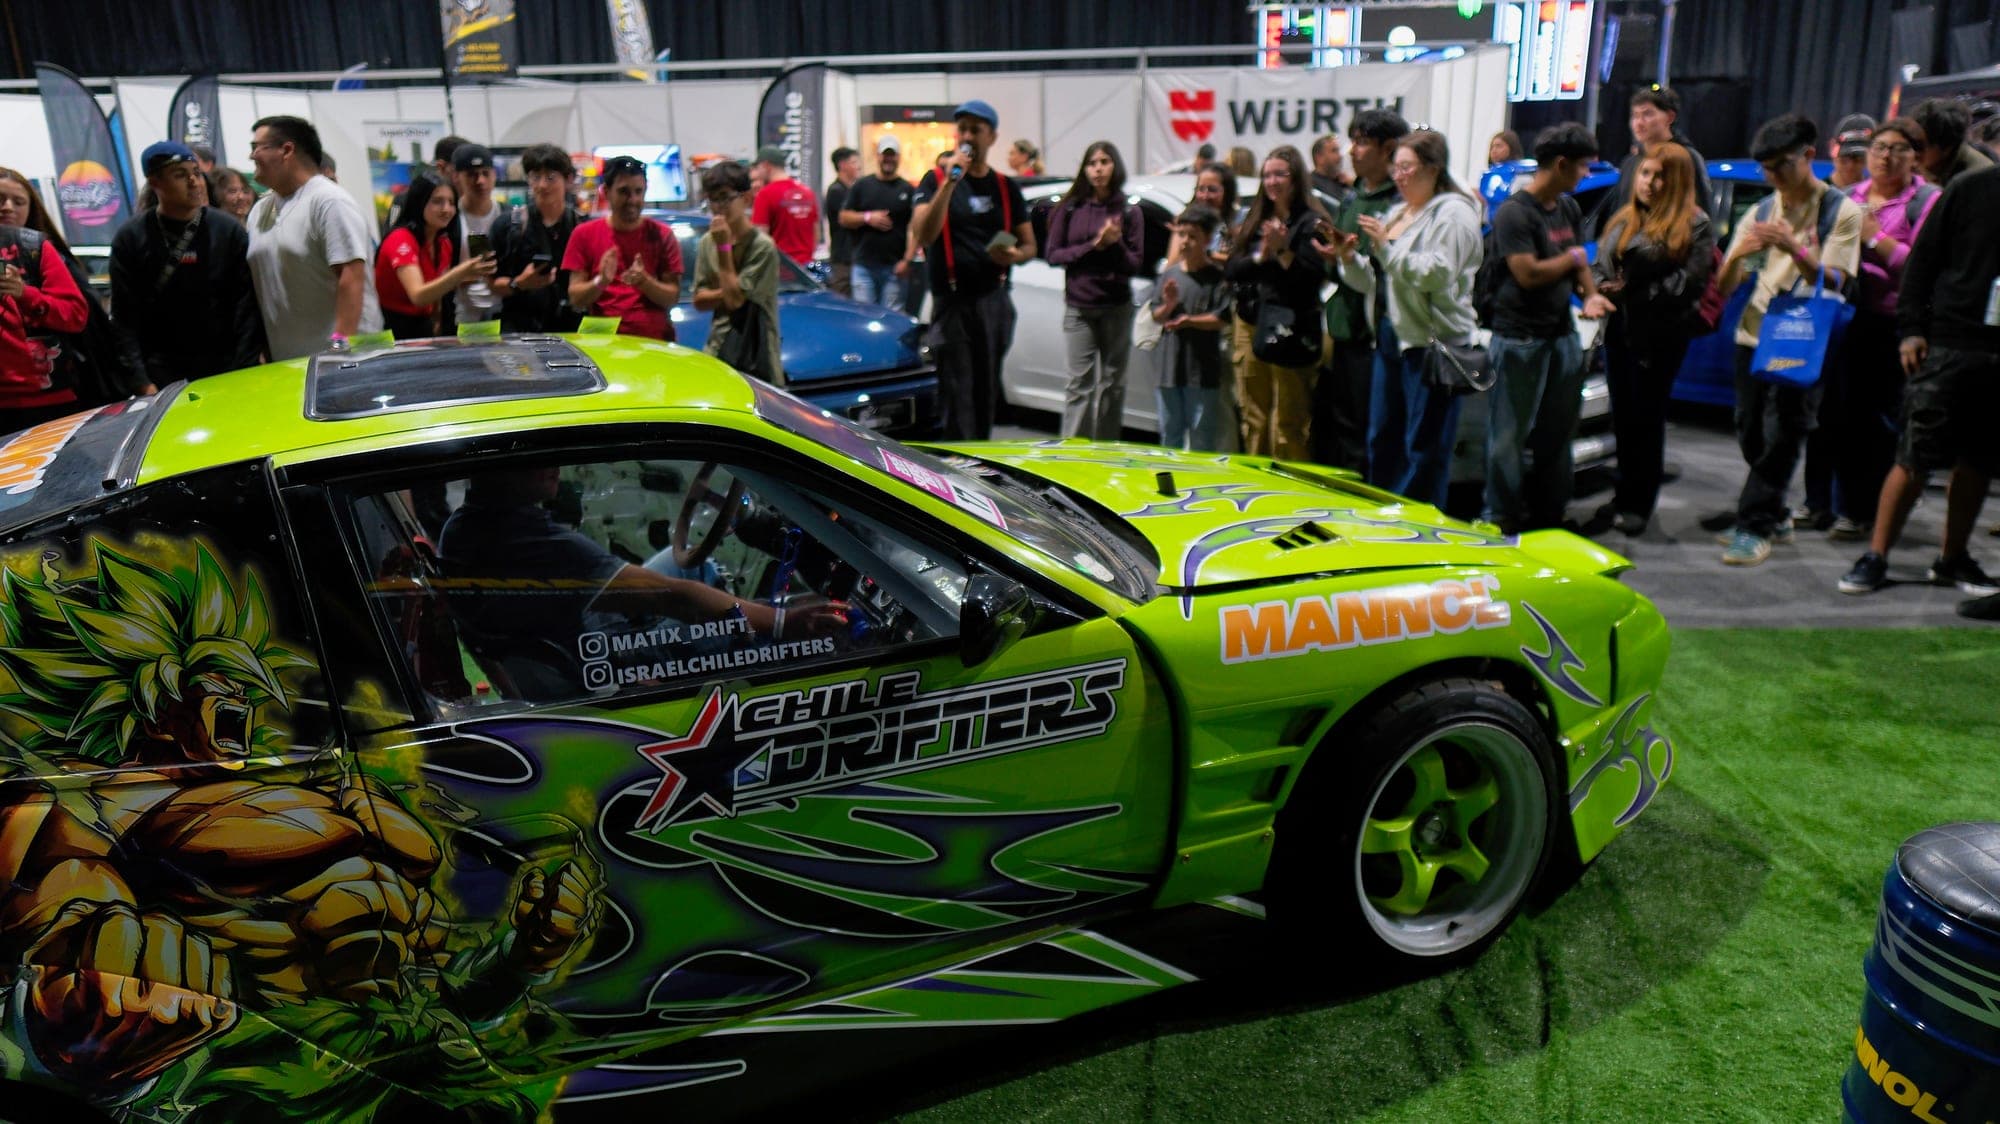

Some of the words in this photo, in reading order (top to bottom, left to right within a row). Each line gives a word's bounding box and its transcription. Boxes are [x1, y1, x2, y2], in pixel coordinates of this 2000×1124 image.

[617, 637, 835, 685] ISRAELCHILEDRIFTERS
[739, 670, 921, 732] CHILE
[766, 664, 1127, 787] DRIFTERS
